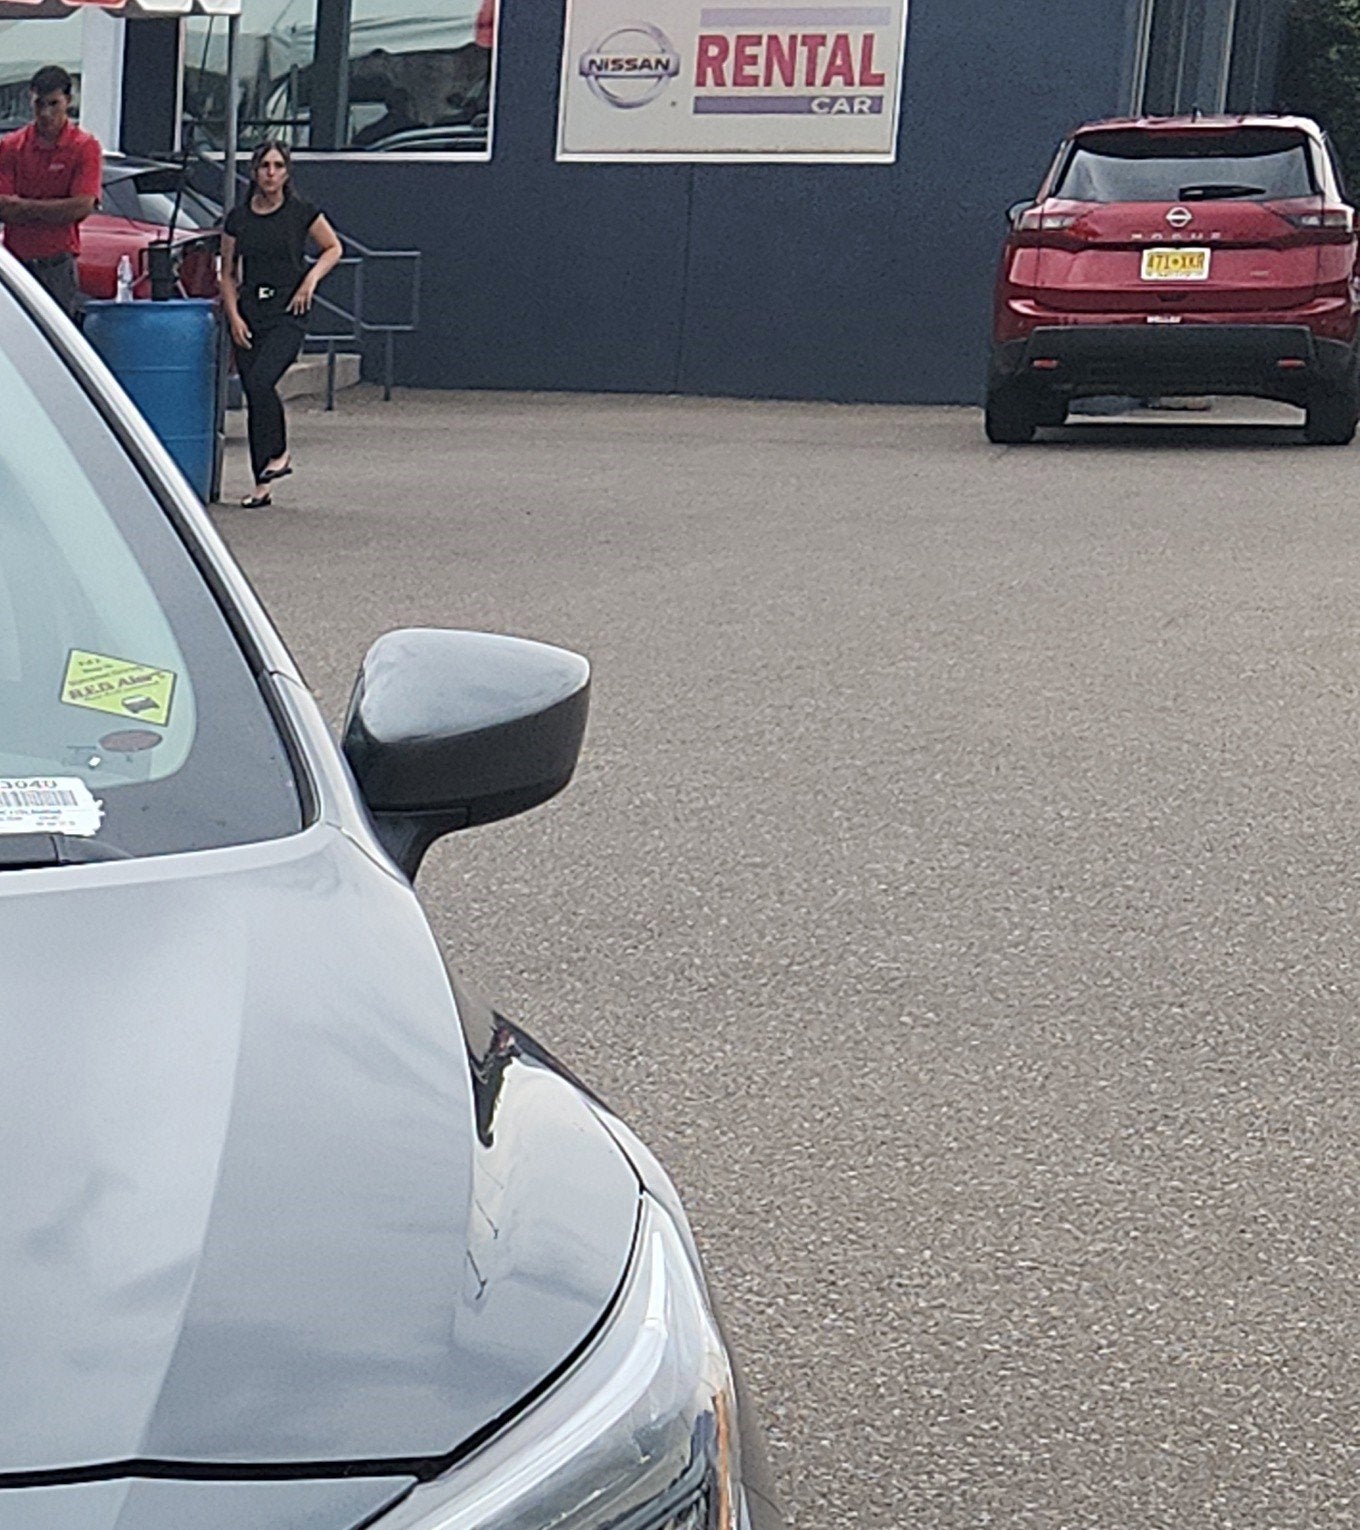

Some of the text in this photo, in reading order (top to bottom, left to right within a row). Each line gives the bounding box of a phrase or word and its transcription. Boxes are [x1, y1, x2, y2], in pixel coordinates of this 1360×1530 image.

[588, 57, 671, 73] NISSAN
[694, 33, 886, 88] RENTAL
[810, 97, 873, 114] CAR
